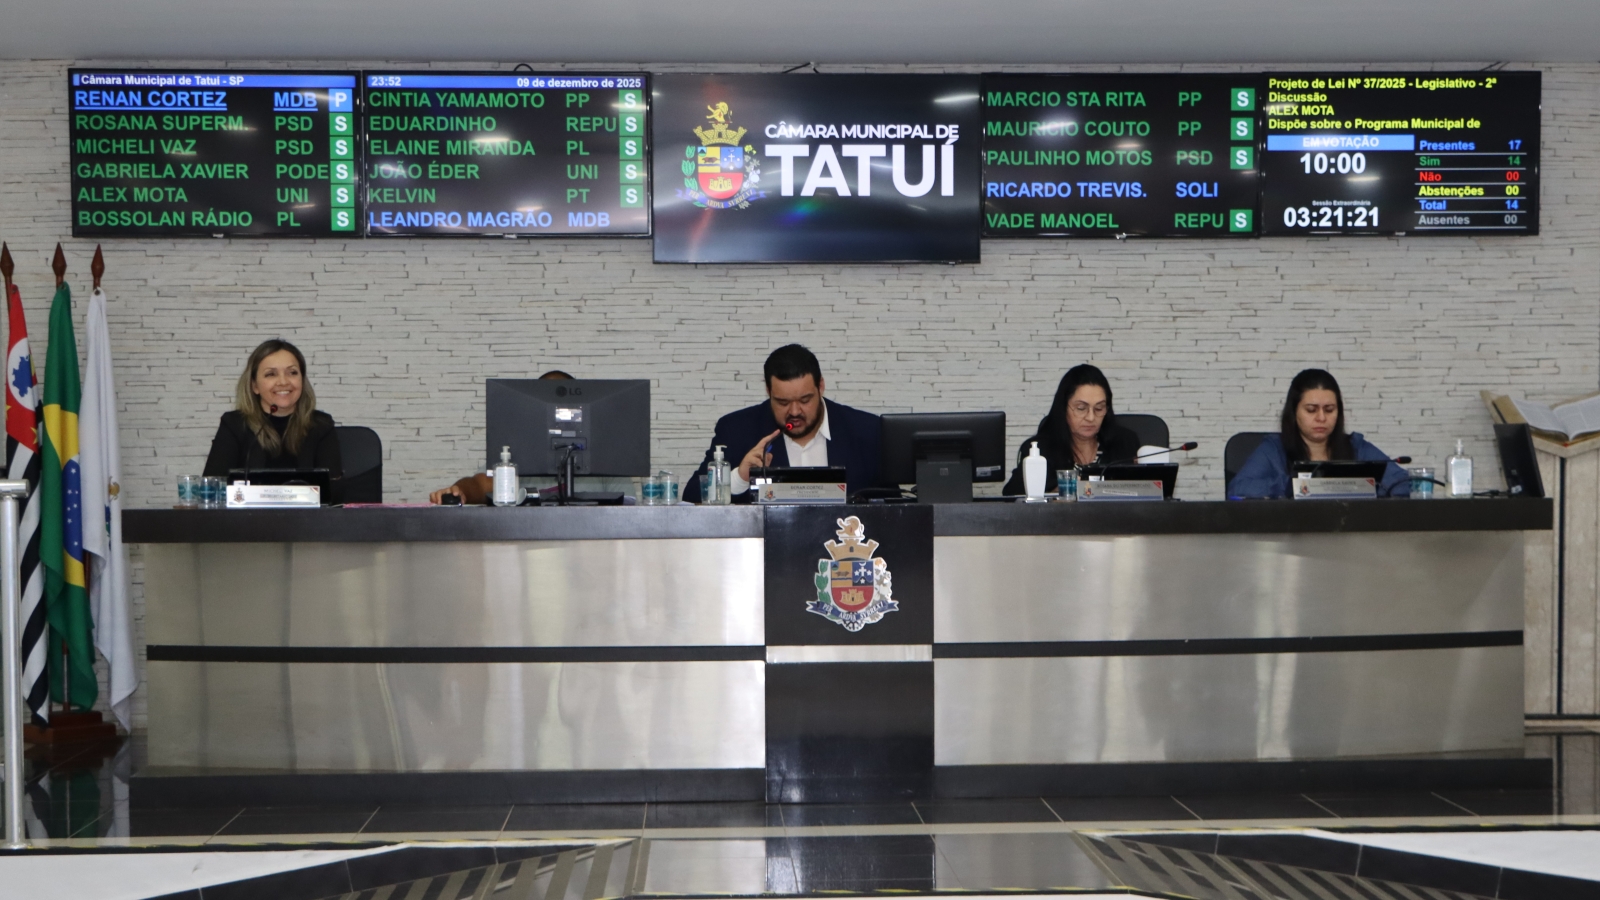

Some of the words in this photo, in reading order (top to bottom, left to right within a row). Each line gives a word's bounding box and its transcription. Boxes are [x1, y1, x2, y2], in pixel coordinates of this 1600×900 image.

[81, 75, 122, 85] Câmara
[124, 76, 176, 87] Municipal
[179, 76, 192, 85] de
[194, 76, 220, 85] Tatuí
[229, 76, 244, 86] SP
[371, 77, 401, 87] 23:52
[517, 78, 529, 88] 09
[532, 78, 546, 88] de
[548, 78, 599, 88] dezembro
[601, 79, 614, 88] de
[617, 79, 641, 88] 2025
[1269, 79, 1308, 90] Projeto
[1311, 79, 1326, 89] de
[1328, 79, 1345, 89] Lei
[1348, 79, 1361, 89] Nº
[1364, 78, 1405, 89] 37/2025
[1415, 79, 1475, 90] Legislativo
[75, 91, 141, 106] RENAN
[148, 91, 227, 107] CORTEZ
[274, 92, 317, 107] MDB
[335, 92, 347, 105] P
[369, 92, 431, 107] CINTIA
[436, 92, 545, 108] YAMAMOTO
[566, 93, 590, 108] PP
[624, 92, 636, 107] S
[987, 92, 1061, 107] MARCIO
[1066, 92, 1100, 107] STA
[1106, 92, 1146, 107] RITA
[1179, 92, 1202, 106] PP
[1237, 92, 1249, 107] S
[1269, 92, 1327, 103] Discussão
[1269, 106, 1299, 116] ALEX
[1302, 106, 1334, 116] MOTA
[76, 115, 157, 130] ROSANA
[163, 116, 249, 131] SUPERM.
[275, 117, 313, 131] PSD
[335, 116, 347, 131] S
[370, 116, 496, 131] EDUARDINHO
[567, 117, 617, 132] REPU
[625, 117, 637, 132] S
[765, 121, 839, 139] CÂMARA
[842, 124, 934, 139] MUNICIPAL
[936, 125, 959, 139] DE
[987, 121, 1079, 136] MAURICIO
[1084, 122, 1150, 136] COUTO
[1179, 122, 1202, 136] PP
[1236, 121, 1248, 136] S
[1269, 119, 1308, 131] Dispõe
[1310, 119, 1342, 129] sobre
[1345, 121, 1351, 129] o
[1354, 119, 1408, 131] Programa
[1411, 119, 1465, 131] Municipal
[1467, 119, 1480, 129] de
[76, 139, 154, 154] MICHELI
[160, 140, 197, 154] VAZ
[275, 140, 314, 155] PSD
[335, 140, 348, 155] S
[370, 140, 440, 155] ELAINE
[446, 140, 535, 155] MIRANDA
[567, 141, 589, 155] PL
[625, 140, 637, 155] S
[1303, 138, 1321, 147] EM
[1323, 136, 1379, 149] VOTAÇÃO
[1420, 140, 1475, 153] Presentes
[1508, 140, 1521, 150] 17
[987, 151, 1080, 166] PAULINHO
[1086, 151, 1152, 166] MOTOS
[1176, 151, 1212, 166] PSD
[1235, 151, 1248, 165] S
[1300, 153, 1366, 174] 10:00
[1419, 156, 1440, 166] Sim
[1508, 156, 1520, 166] 14
[77, 163, 175, 178] GABRIELA
[181, 164, 248, 179] XAVIER
[276, 164, 329, 179] PODE
[336, 164, 348, 179] S
[370, 161, 422, 179] JOÃO
[428, 161, 480, 179] ÉDER
[567, 165, 598, 179] UNI
[625, 164, 637, 179] S
[765, 138, 959, 197] TATUÍ
[1419, 172, 1442, 182] Não
[1506, 171, 1519, 181] 00
[78, 188, 128, 202] ALEX
[133, 188, 188, 202] MOTA
[277, 188, 308, 203] UNI
[336, 188, 348, 203] S
[370, 188, 436, 203] KELVIN
[567, 188, 590, 203] PT
[626, 188, 638, 203] S
[986, 183, 1071, 198] RICARDO
[1077, 183, 1147, 198] TREVIS.
[1175, 183, 1218, 198] SOLI
[1419, 186, 1484, 198] Abstenções
[1506, 185, 1519, 196] 00
[1419, 200, 1446, 211] Total
[1506, 200, 1518, 210] 14
[78, 211, 185, 226] BOSSOLAN
[192, 208, 252, 226] RÁDIO
[277, 212, 301, 226] PL
[337, 212, 349, 227] S
[370, 212, 462, 227] LEANDRO
[568, 213, 610, 227] MDB
[986, 214, 1034, 228] VADE
[1041, 214, 1119, 228] MANOEL
[1175, 214, 1224, 228] REPU
[1234, 214, 1247, 228] S
[1283, 207, 1379, 227] 03:21:21
[1419, 215, 1470, 225] Ausentes
[1504, 215, 1517, 225] 00
[569, 388, 582, 396] LG
